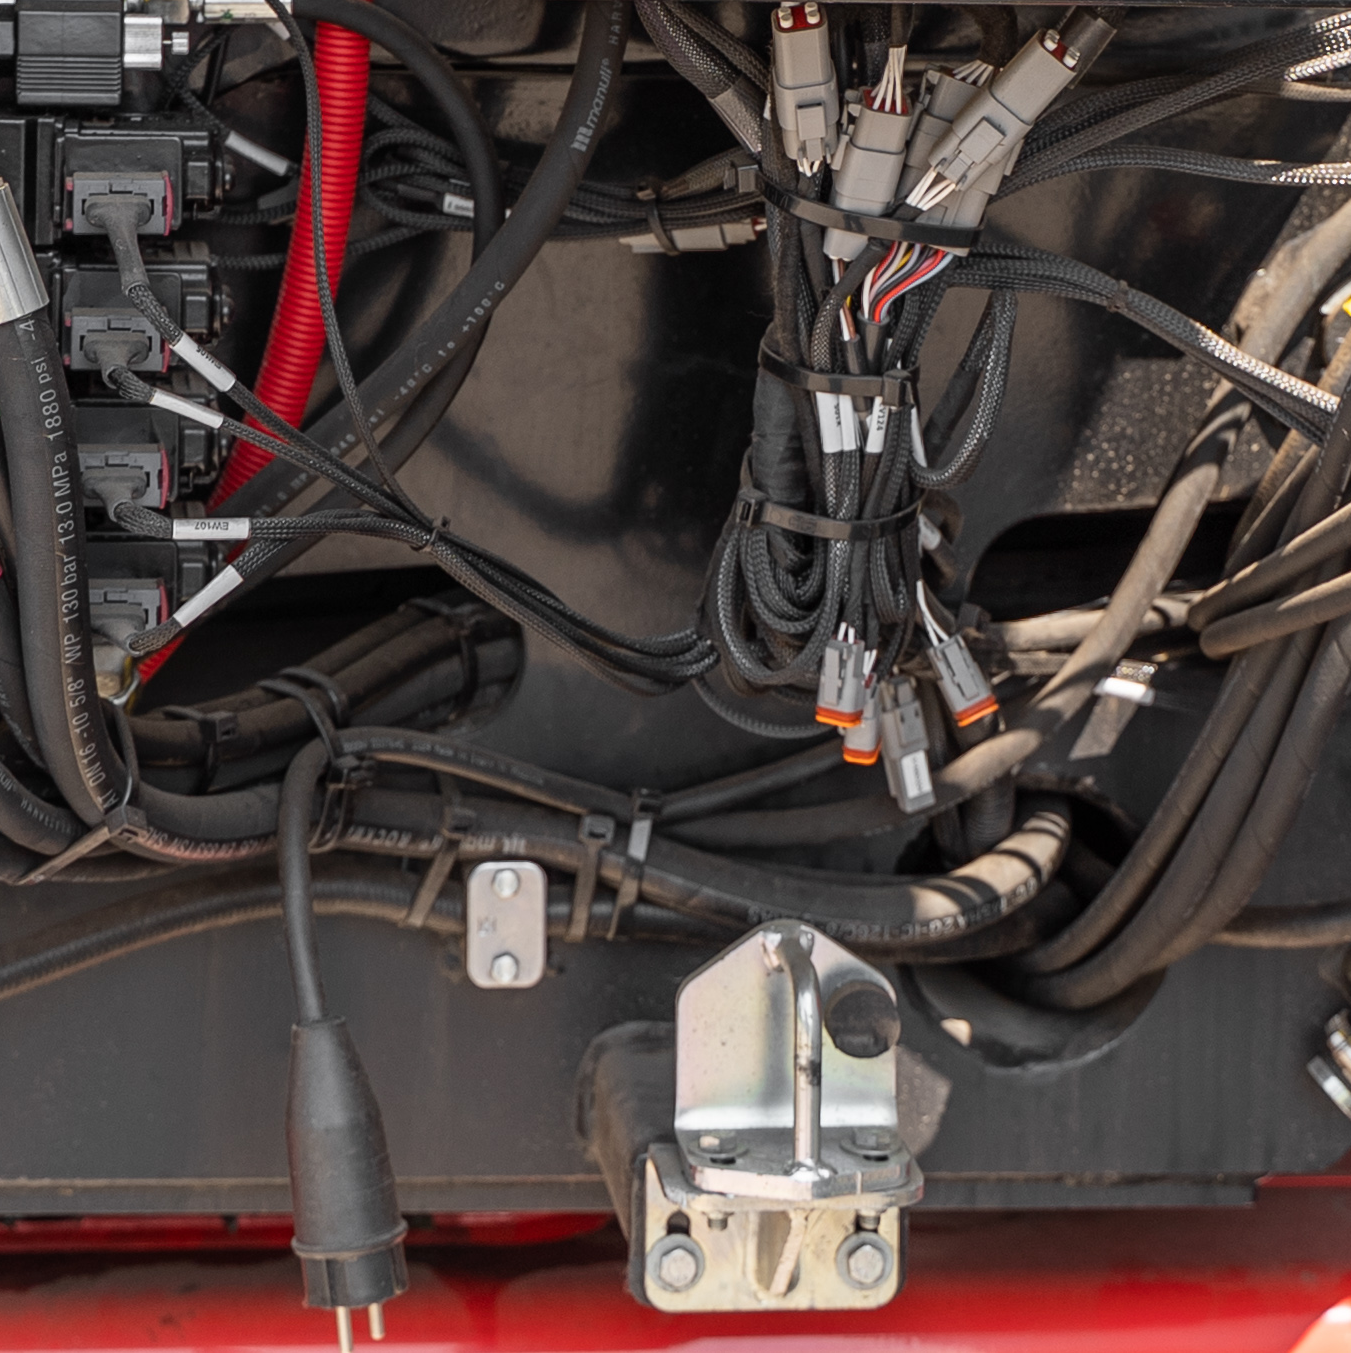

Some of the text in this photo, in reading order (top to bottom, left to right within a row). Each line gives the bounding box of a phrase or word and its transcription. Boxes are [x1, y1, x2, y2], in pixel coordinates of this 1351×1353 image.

[30, 352, 53, 384] psi
[39, 389, 64, 441] 1880
[51, 450, 72, 497] MPa
[55, 500, 76, 544] 13.0
[194, 520, 229, 532] EW107
[60, 555, 78, 586] bar
[61, 589, 79, 624] 130
